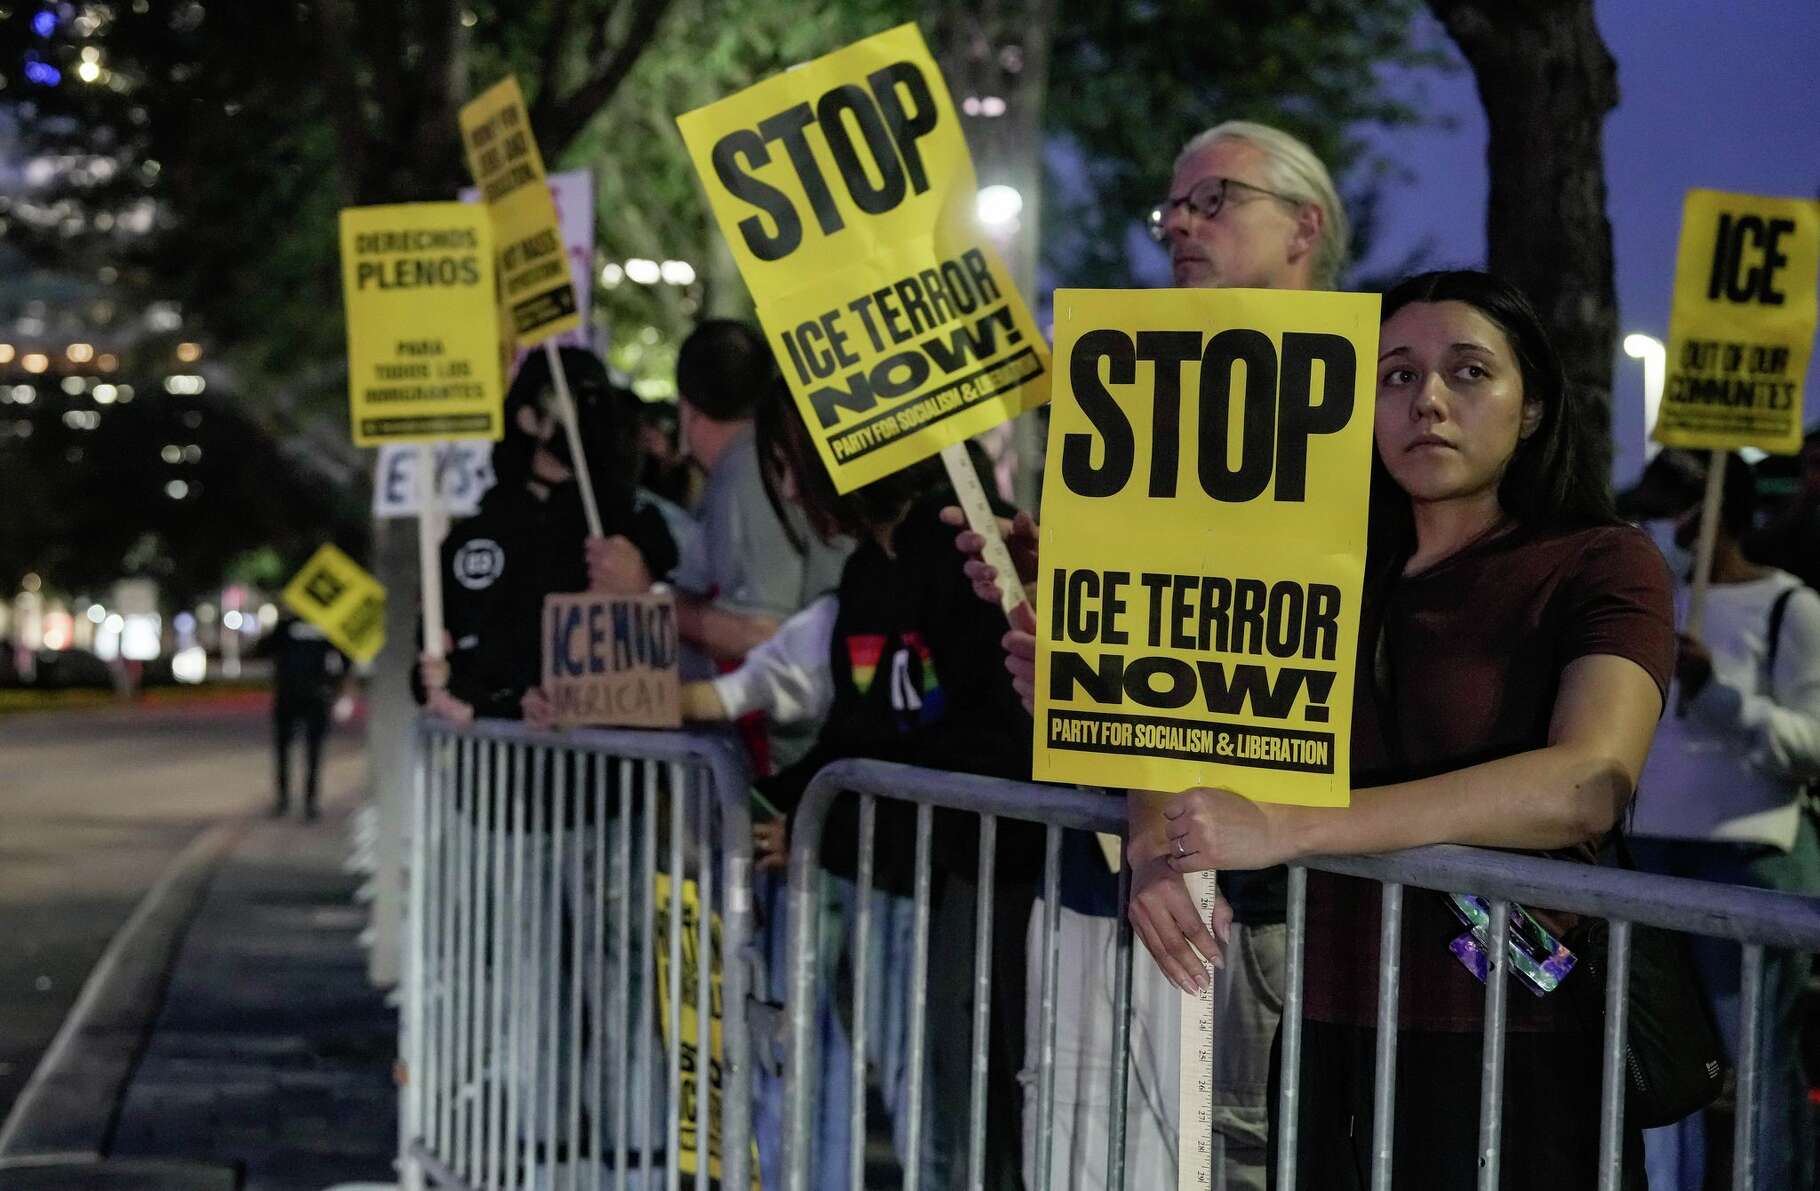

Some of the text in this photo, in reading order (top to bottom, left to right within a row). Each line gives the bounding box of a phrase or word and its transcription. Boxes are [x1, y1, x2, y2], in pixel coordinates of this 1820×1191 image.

[711, 60, 938, 262] STOP
[357, 257, 480, 291] PLENOS
[1708, 213, 1797, 306] ICE
[781, 247, 1002, 386] ICE TERROR
[807, 305, 1024, 429] NOW!
[832, 431, 876, 460] PARTY
[871, 415, 899, 441] FOR
[896, 387, 961, 430] SOCIALISM
[960, 382, 977, 401] &
[1061, 328, 1357, 503] STOP
[1051, 568, 1342, 661] ICE TERROR
[1049, 651, 1337, 723] NOW!
[1051, 718, 1328, 766] PARTY FOR SOCIALISM & LIBERATION
